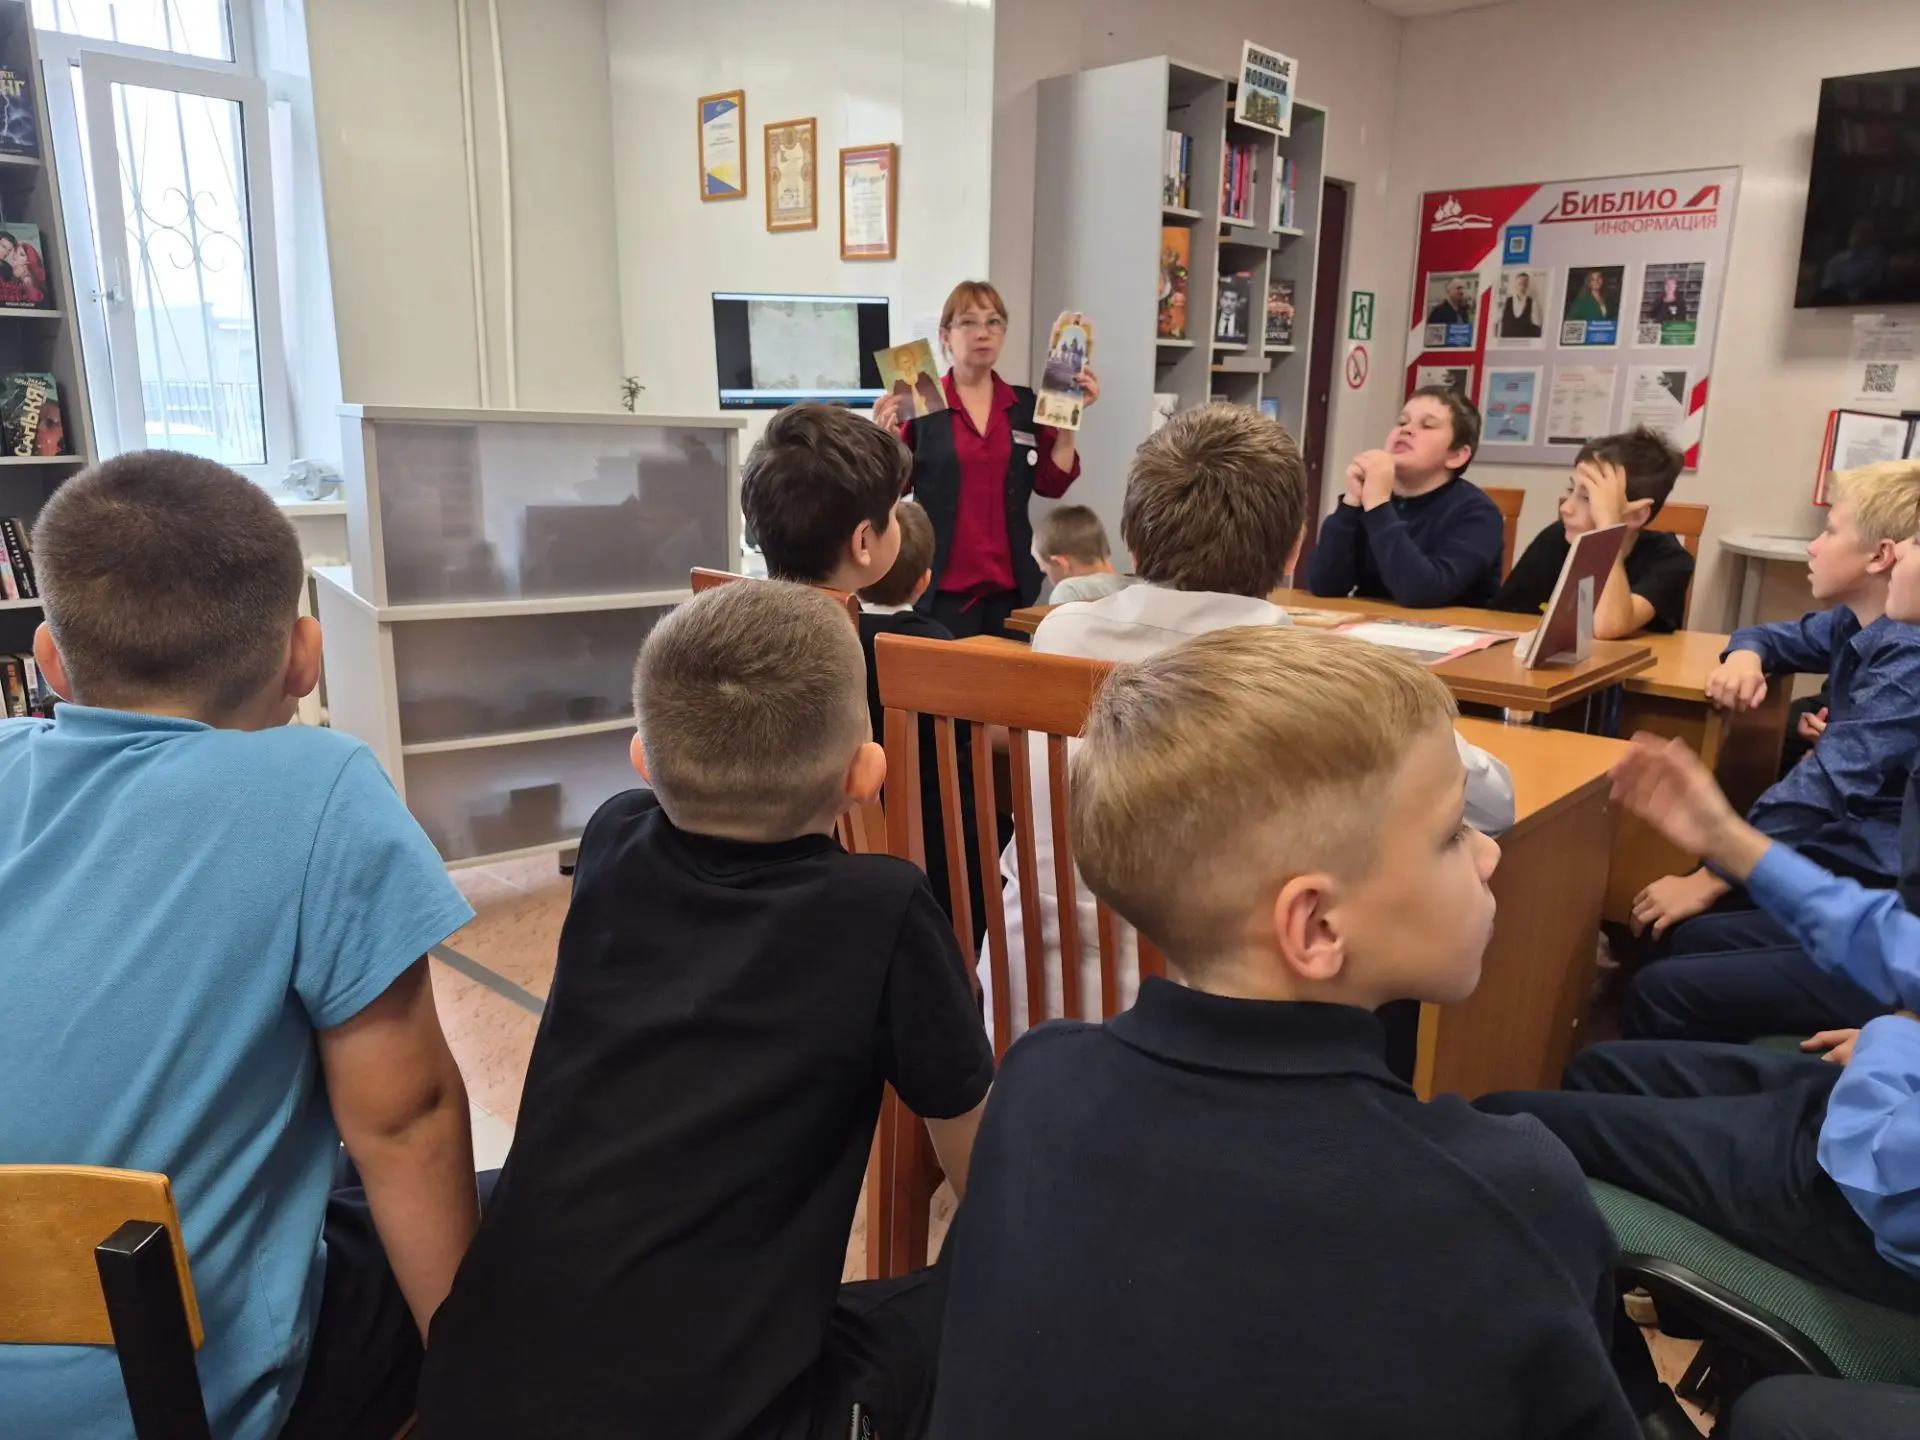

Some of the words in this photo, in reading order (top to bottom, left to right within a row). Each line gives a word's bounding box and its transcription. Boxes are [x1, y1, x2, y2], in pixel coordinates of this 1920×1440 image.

[1246, 47, 1291, 77] КНИЖНЫЕ
[1244, 66, 1288, 96] НОВИНКИ
[1560, 188, 1677, 217] БИБЛИО
[1593, 214, 1718, 236] ИНФОРМАЦИЯ
